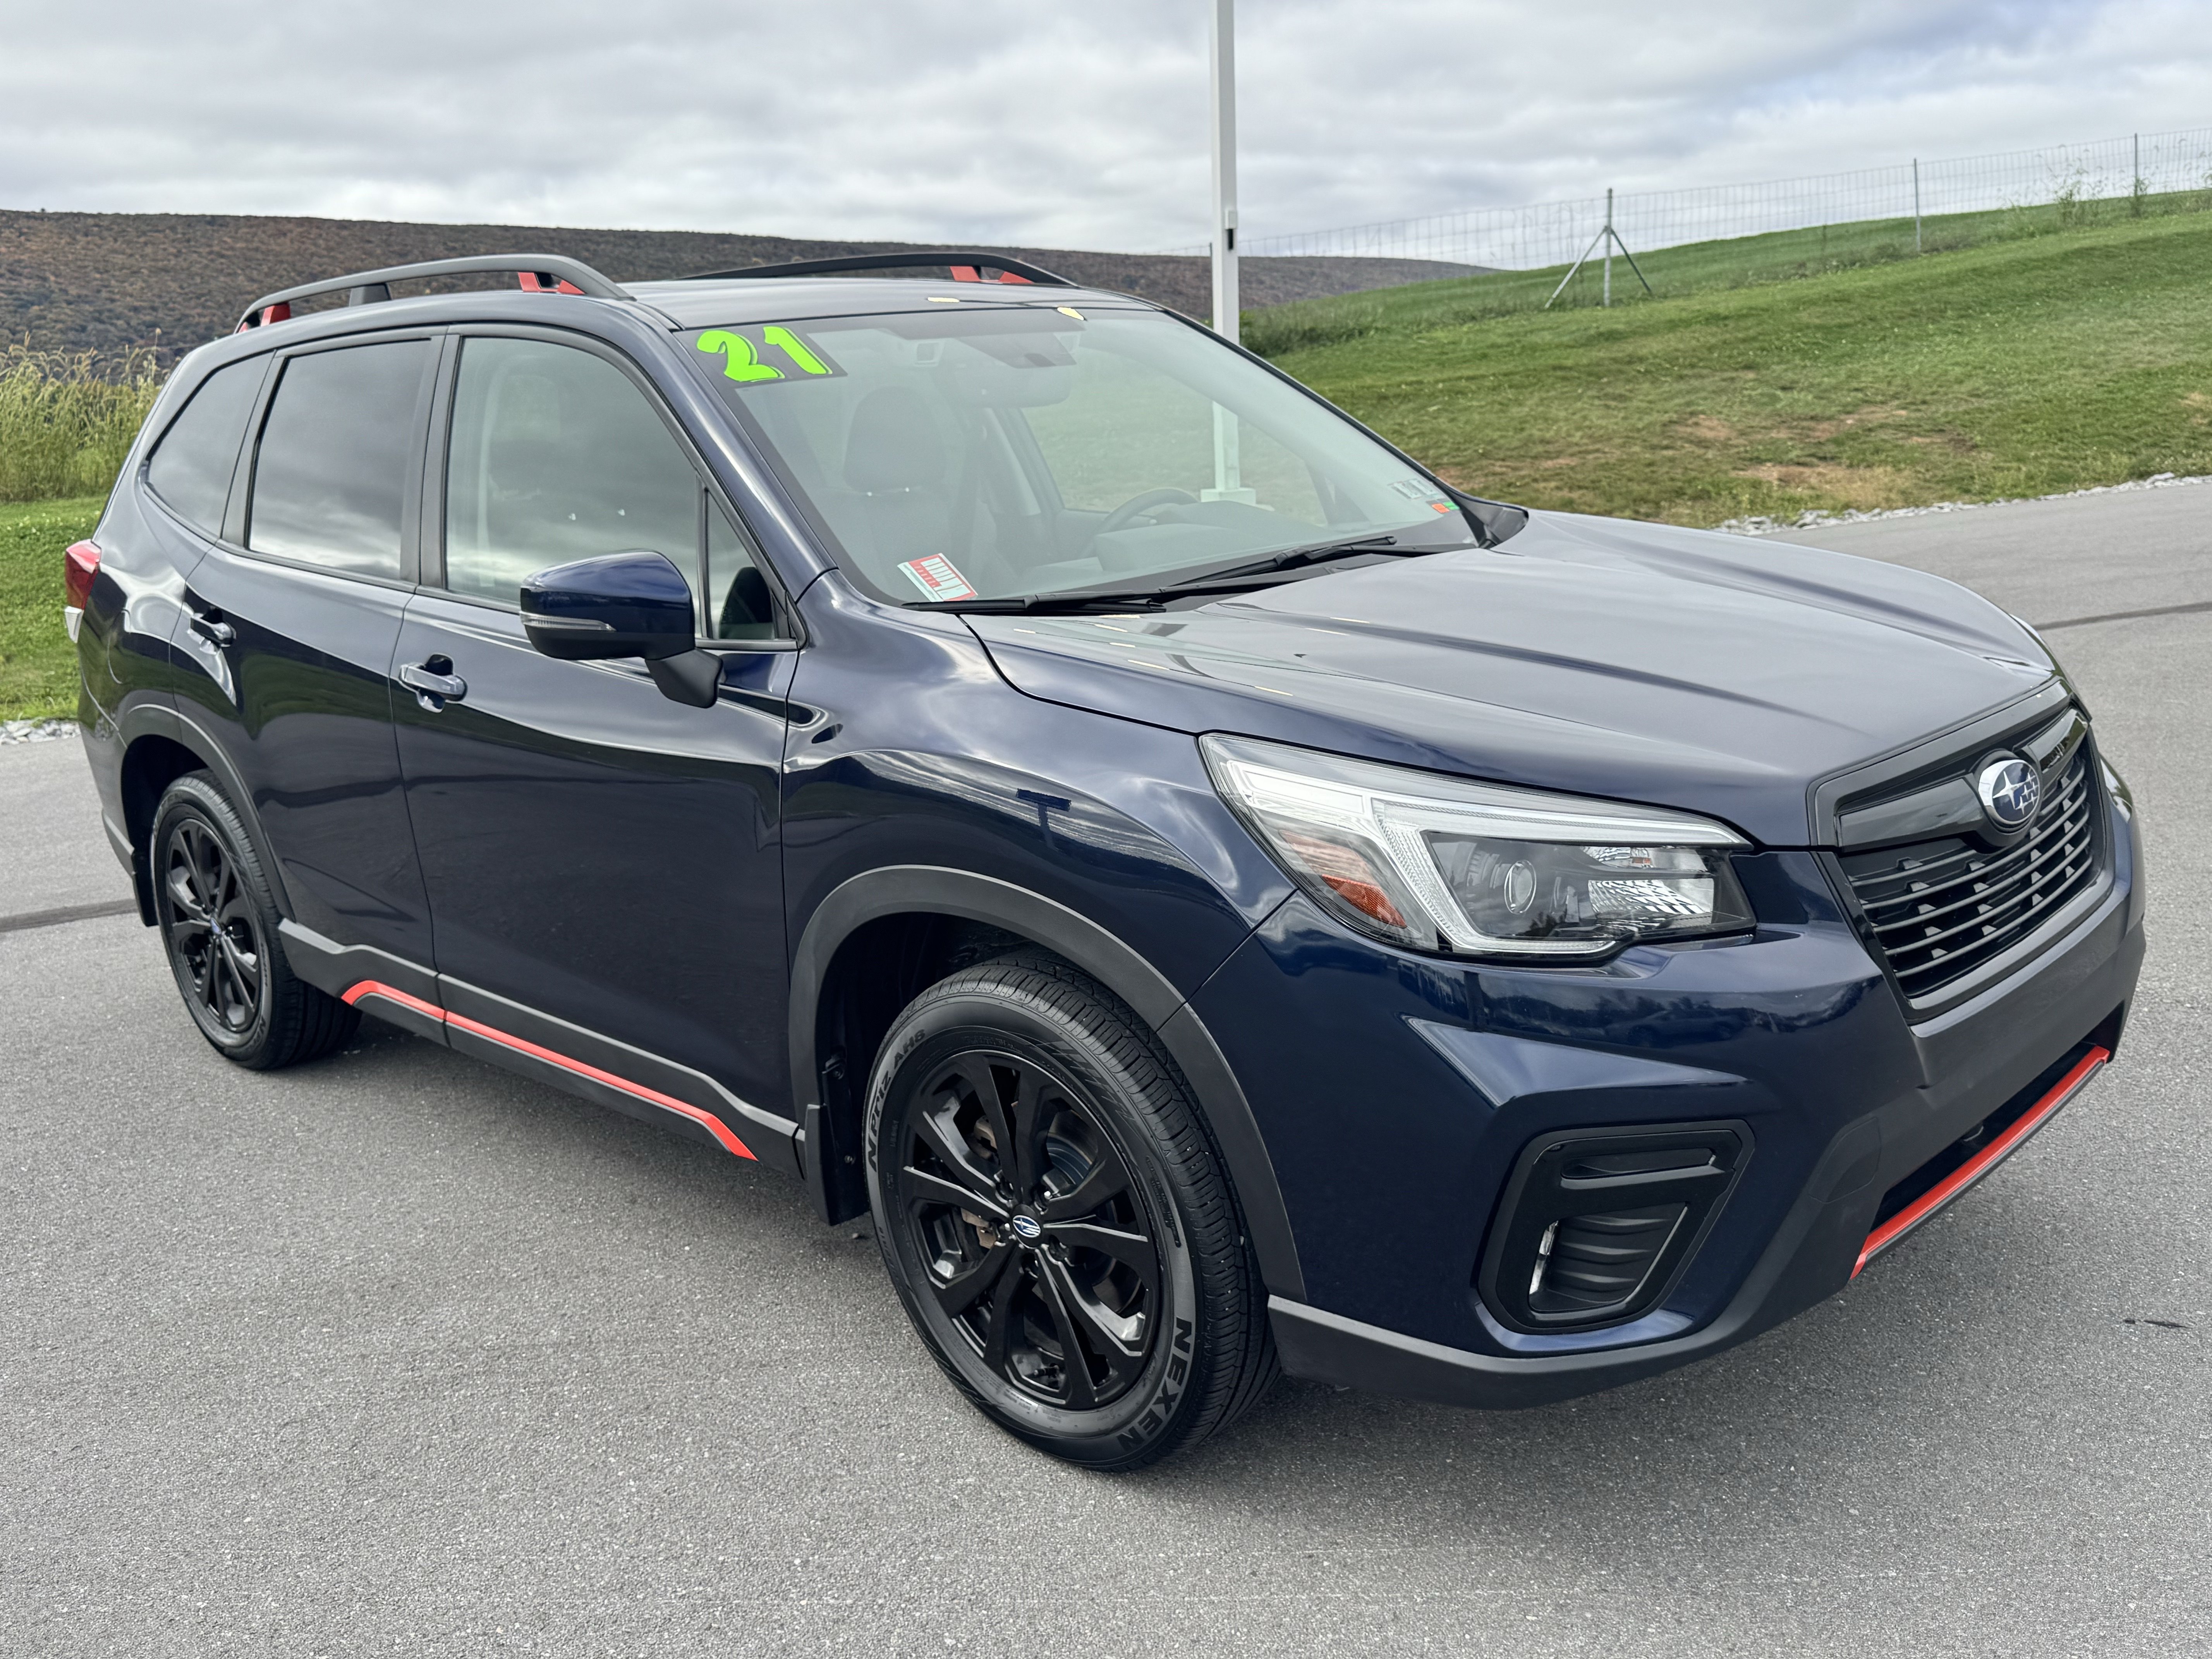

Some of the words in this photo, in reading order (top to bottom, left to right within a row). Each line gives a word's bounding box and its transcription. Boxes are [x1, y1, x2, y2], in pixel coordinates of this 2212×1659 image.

[697, 326, 828, 381] 21
[894, 1029, 925, 1069] AH8
[1116, 1317, 1192, 1451] NEXEN
